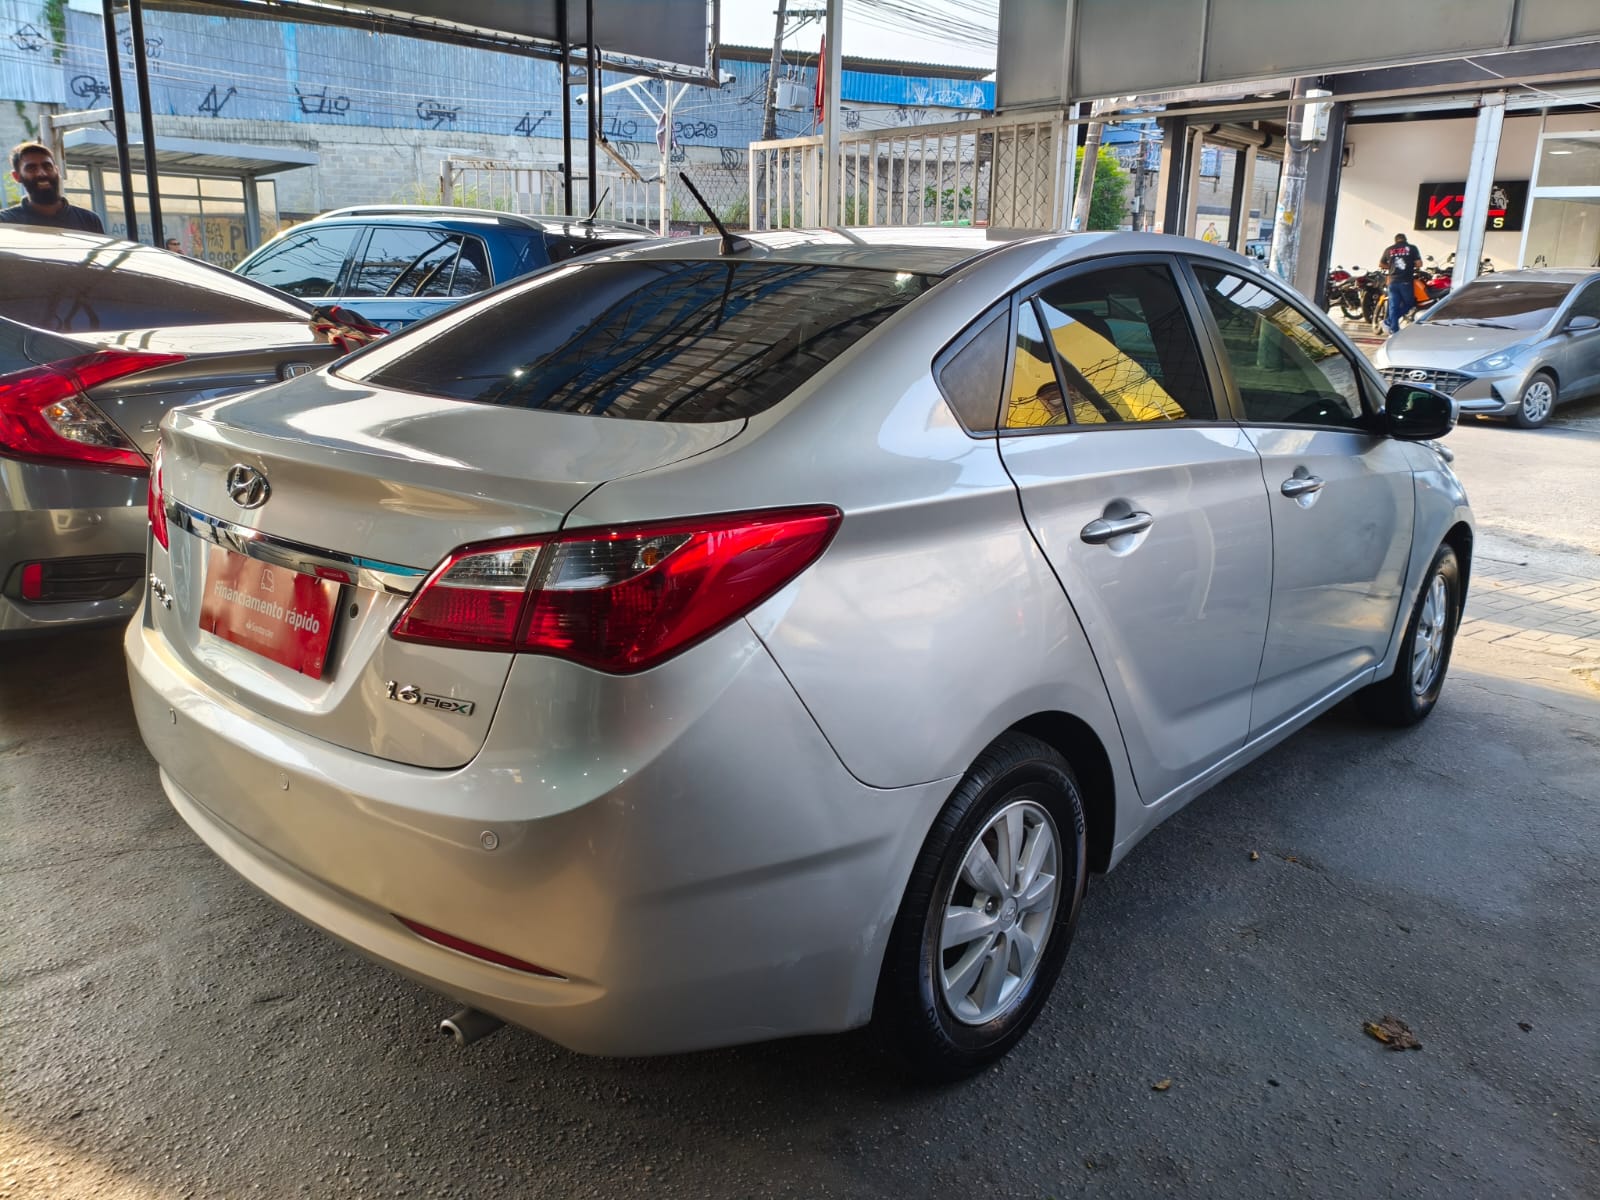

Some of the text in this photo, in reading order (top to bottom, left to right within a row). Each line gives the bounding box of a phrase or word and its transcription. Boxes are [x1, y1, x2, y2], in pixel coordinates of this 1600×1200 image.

[1425, 217, 1505, 229] MOS
[214, 580, 320, 634] Financiamento rápido
